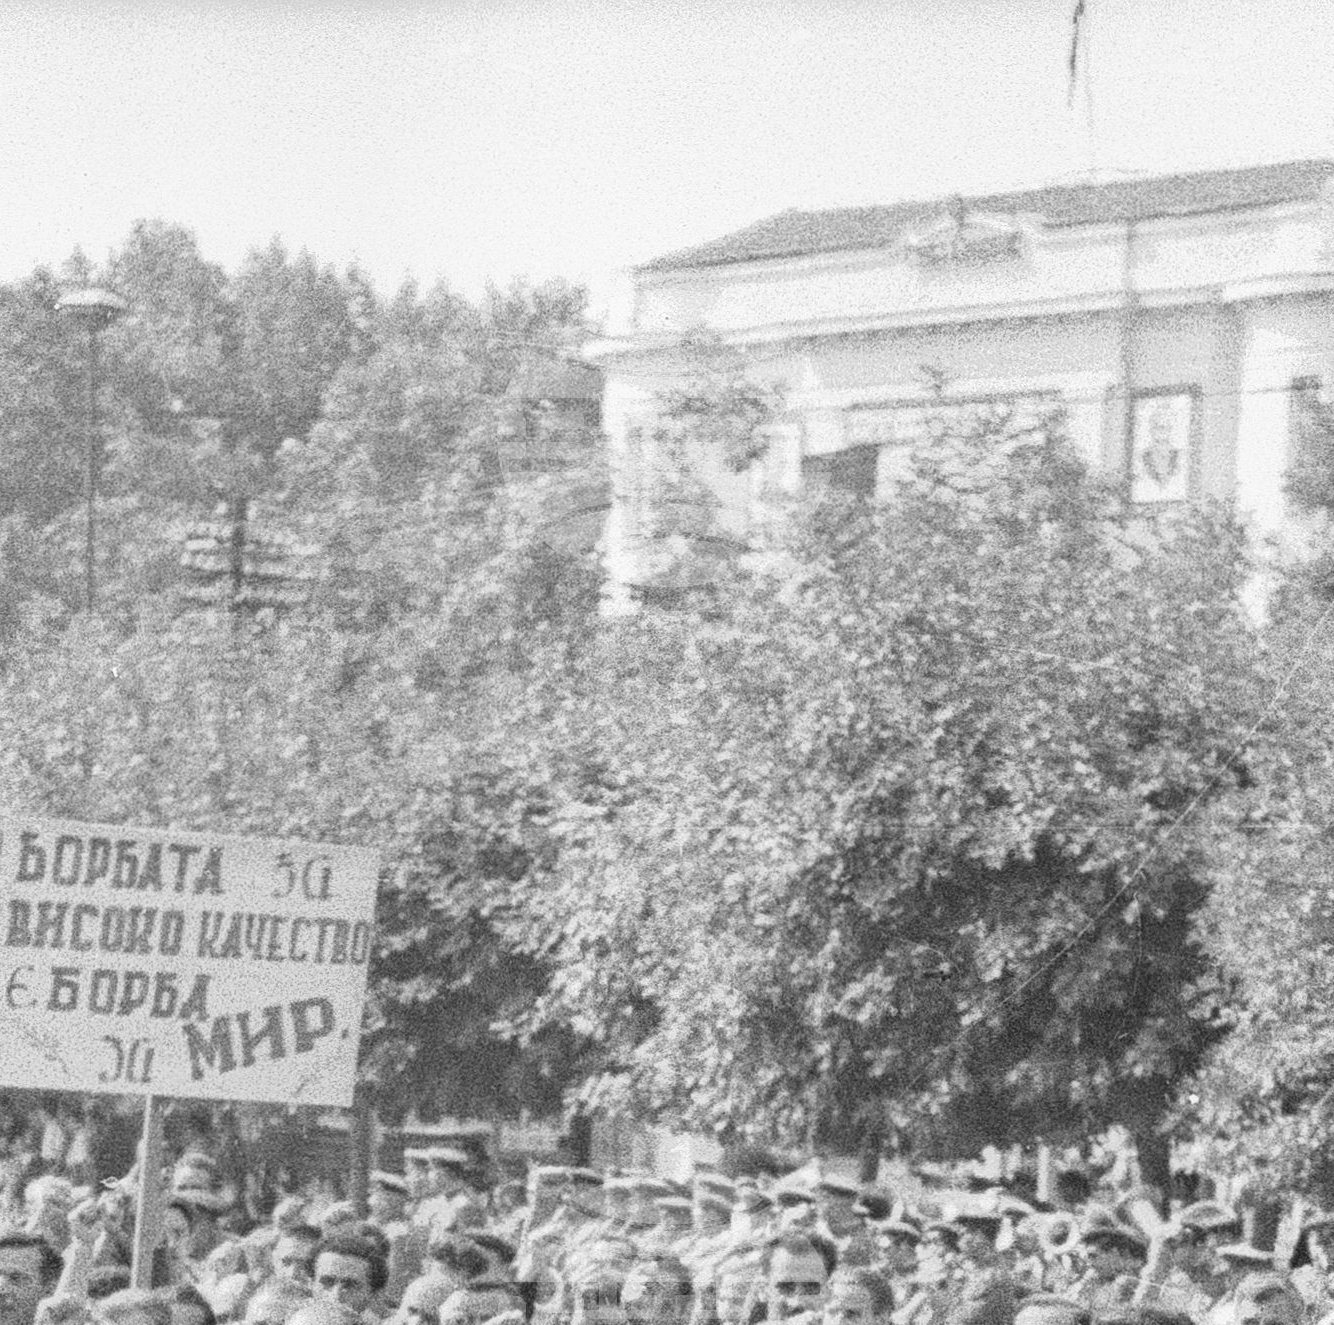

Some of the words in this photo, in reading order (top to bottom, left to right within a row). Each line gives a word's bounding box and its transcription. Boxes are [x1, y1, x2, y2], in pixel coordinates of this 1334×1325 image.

[16, 831, 225, 895] БОРБАТА
[4, 899, 185, 956] ВИСОКО
[197, 908, 369, 966] КАЧЕСТВО
[46, 966, 211, 1022] БОРБА
